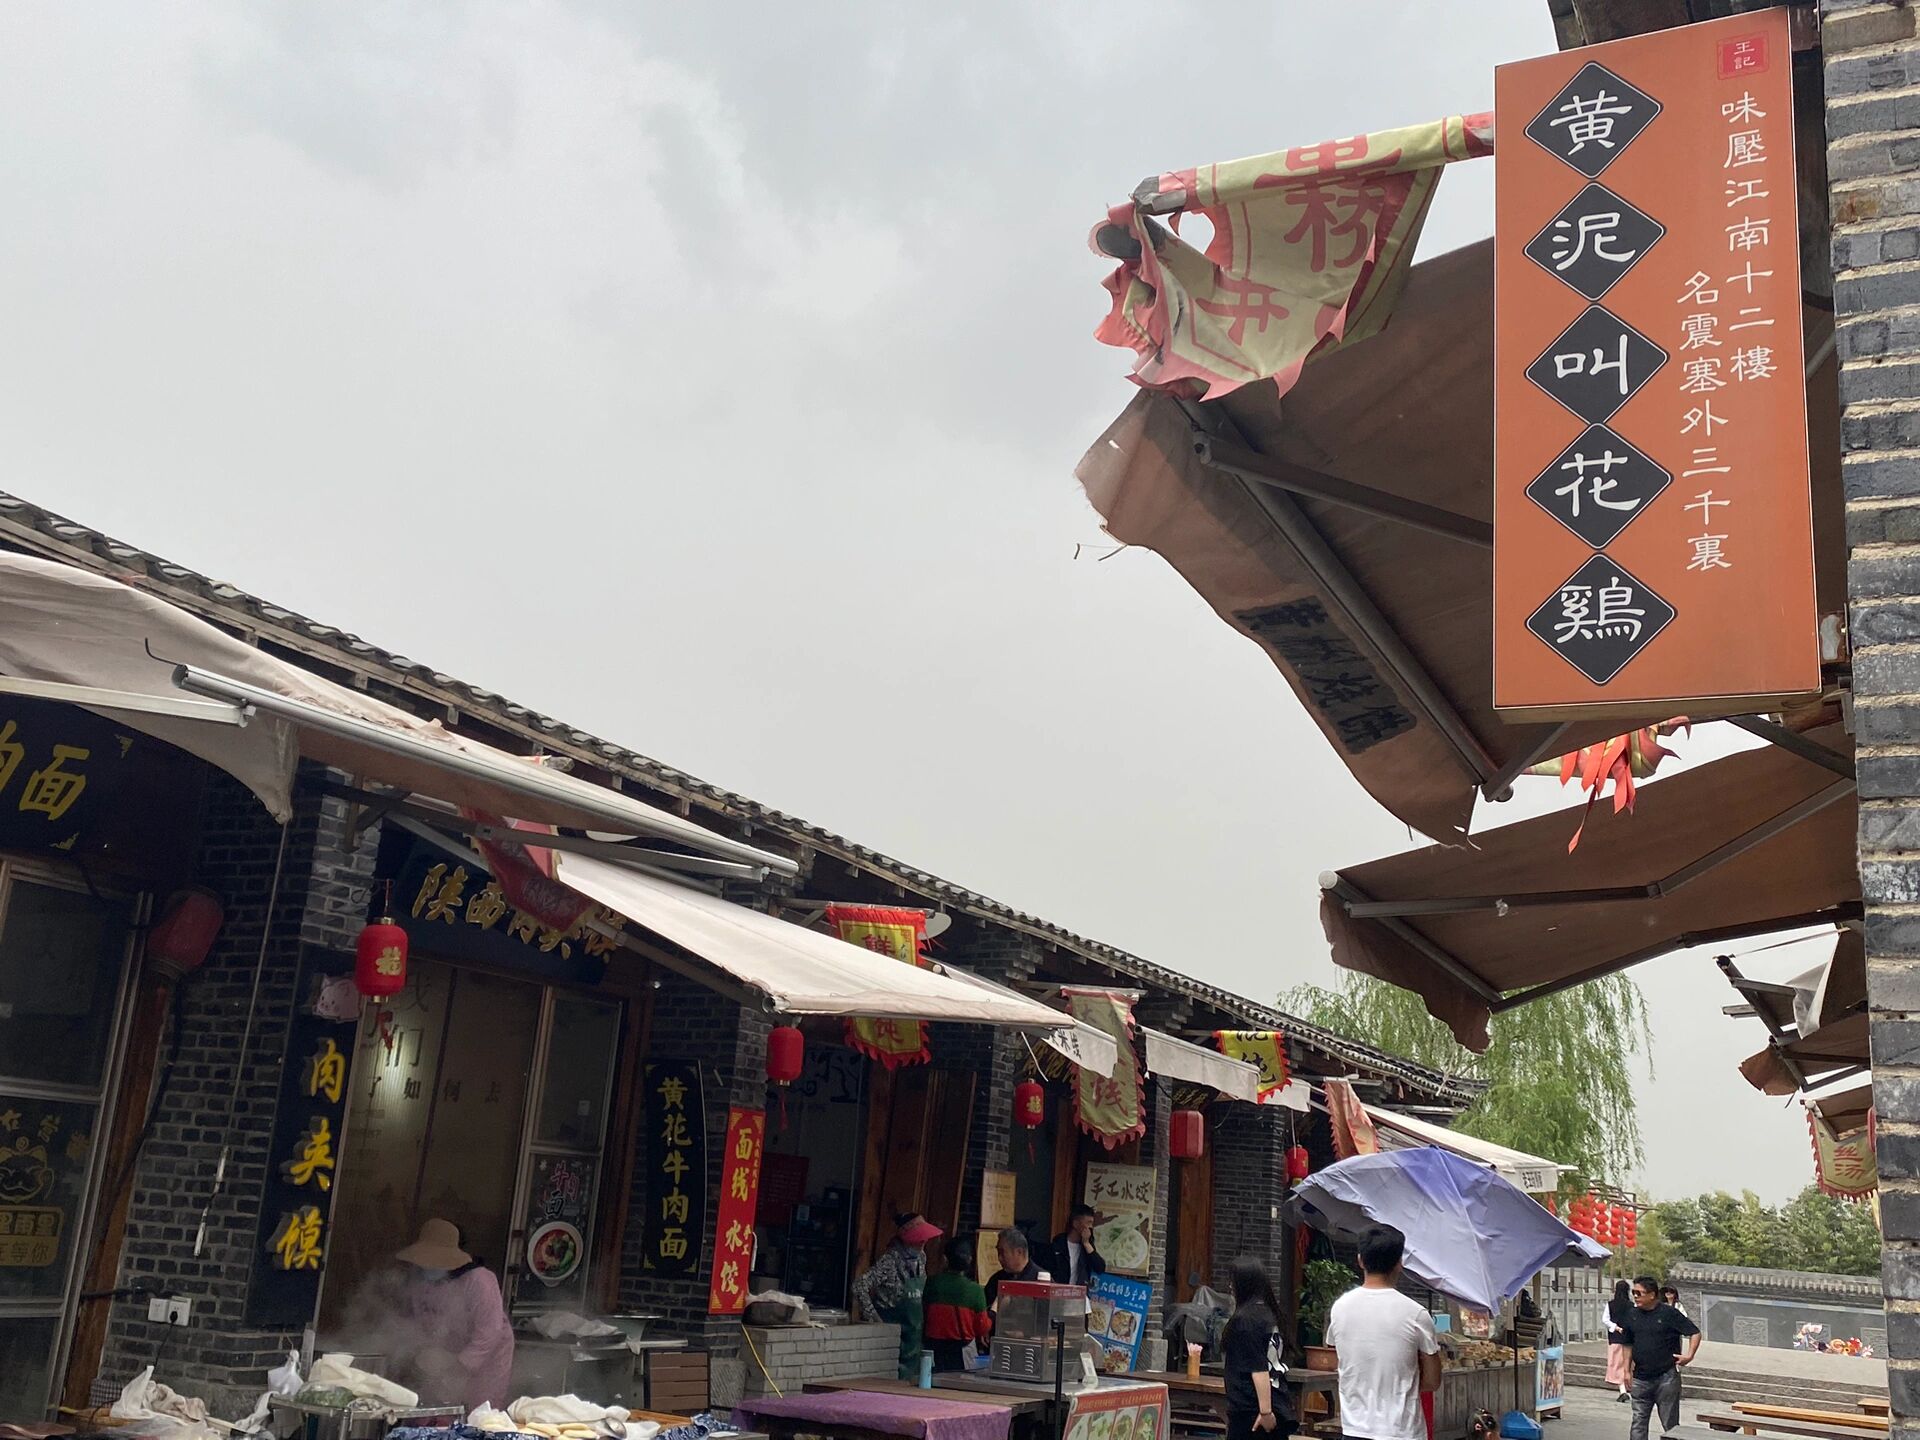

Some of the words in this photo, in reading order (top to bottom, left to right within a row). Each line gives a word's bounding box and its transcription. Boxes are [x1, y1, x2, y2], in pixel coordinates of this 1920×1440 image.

[1733, 40, 1756, 70] 王記
[1721, 91, 1778, 382] 味壓江南十二樓
[1677, 270, 1732, 571] 名震塞外三千裏
[277, 1038, 346, 1271] 肉夹馍
[657, 1076, 693, 1260] 黄花牛肉面
[1090, 1175, 1151, 1204] 手工水饺
[719, 1219, 743, 1294] 水饺
